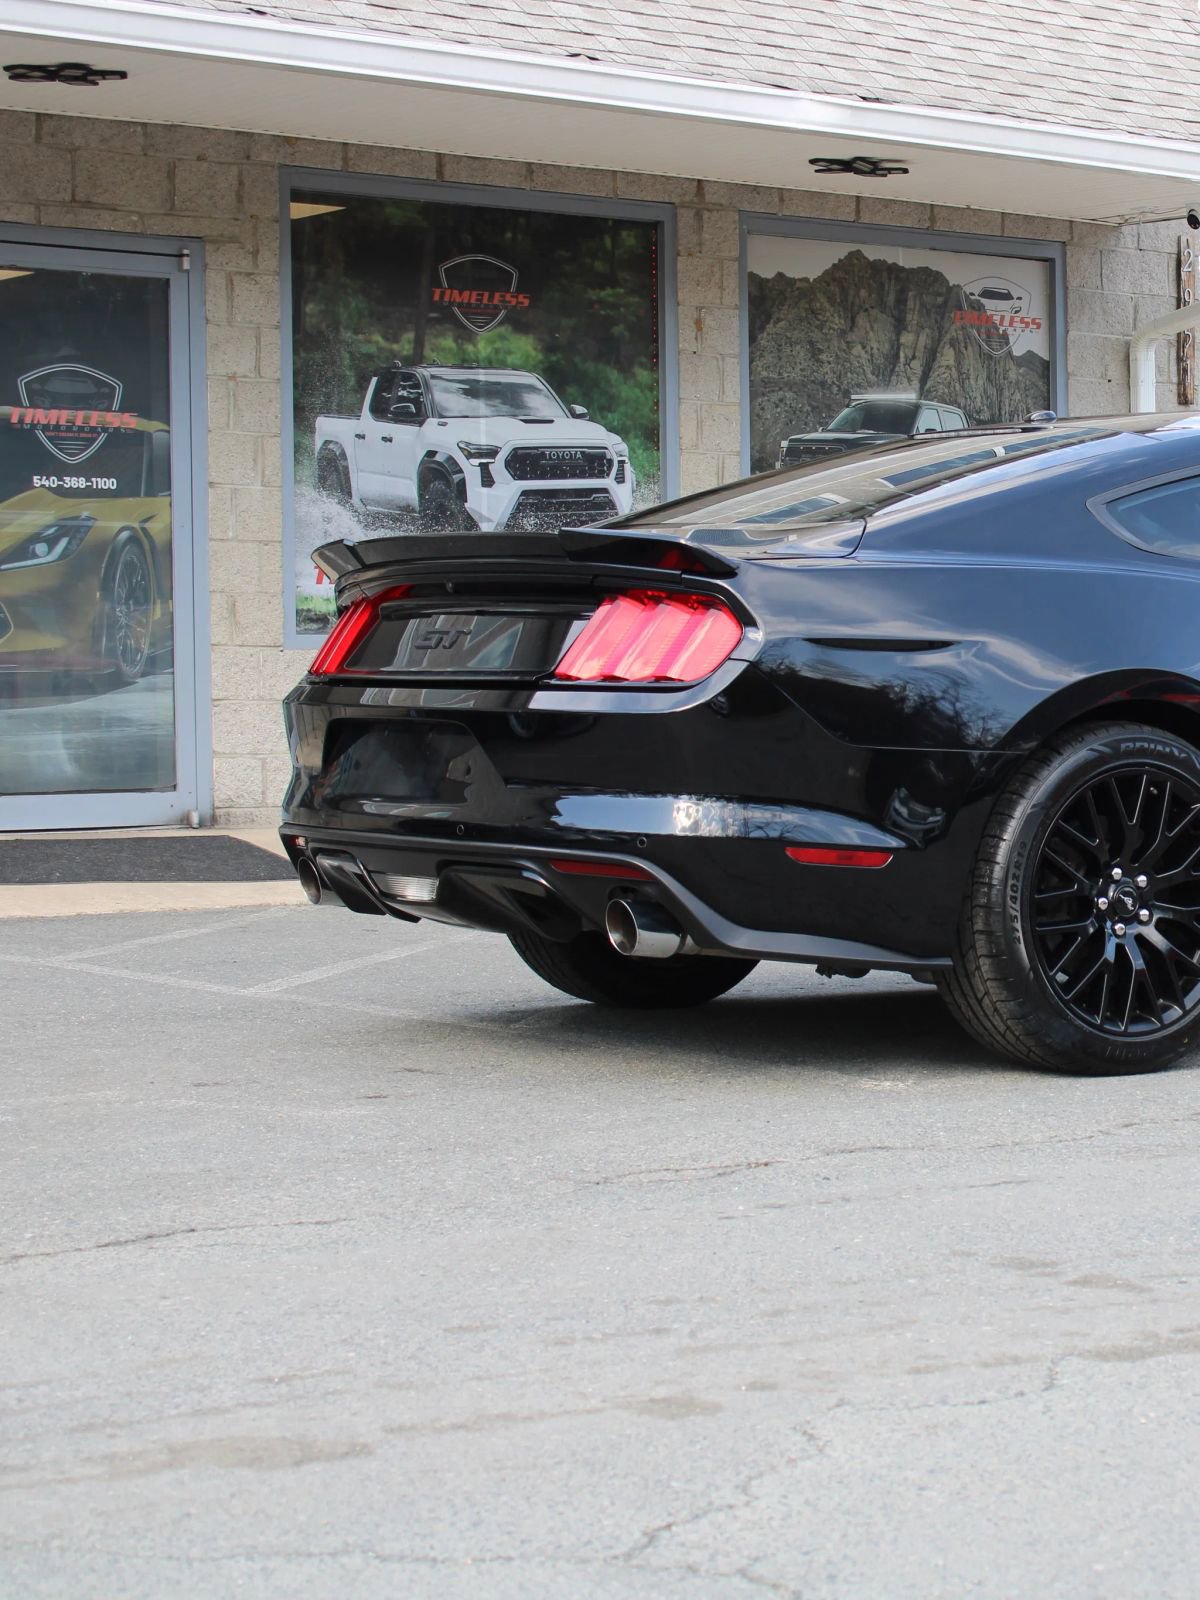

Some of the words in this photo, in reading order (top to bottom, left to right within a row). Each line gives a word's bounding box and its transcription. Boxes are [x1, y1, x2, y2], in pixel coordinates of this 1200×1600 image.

[432, 288, 531, 307] TIMELESS
[953, 309, 1045, 330] TIMELESS
[10, 407, 138, 428] TIMELESS
[545, 451, 583, 460] TOYOTA
[33, 476, 117, 489] 540-368-1100
[414, 628, 472, 650] GT
